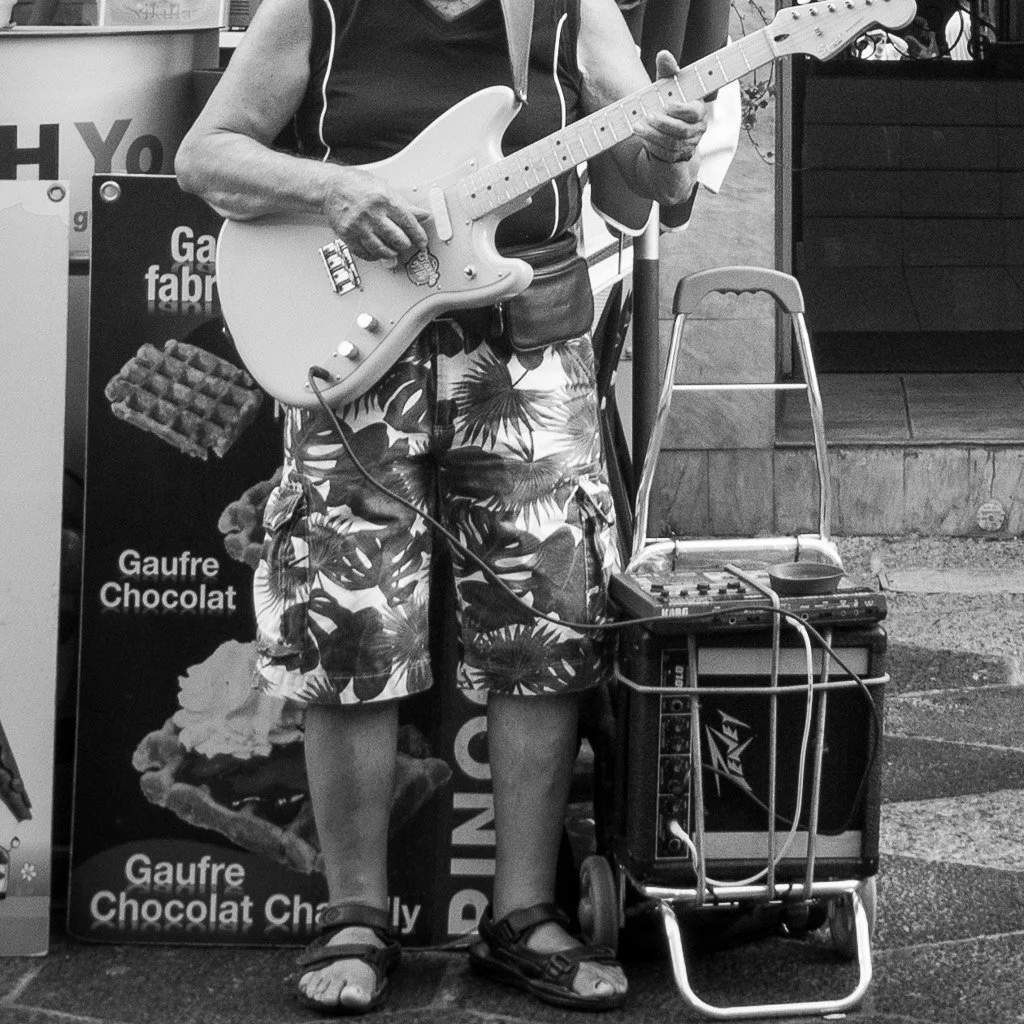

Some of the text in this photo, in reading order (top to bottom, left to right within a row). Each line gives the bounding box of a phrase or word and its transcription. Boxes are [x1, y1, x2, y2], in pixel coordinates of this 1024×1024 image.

[118, 548, 221, 577] Gaufre
[100, 581, 238, 611] Chocolat
[125, 853, 246, 887] Gaufre
[90, 890, 254, 925] Chocolat
